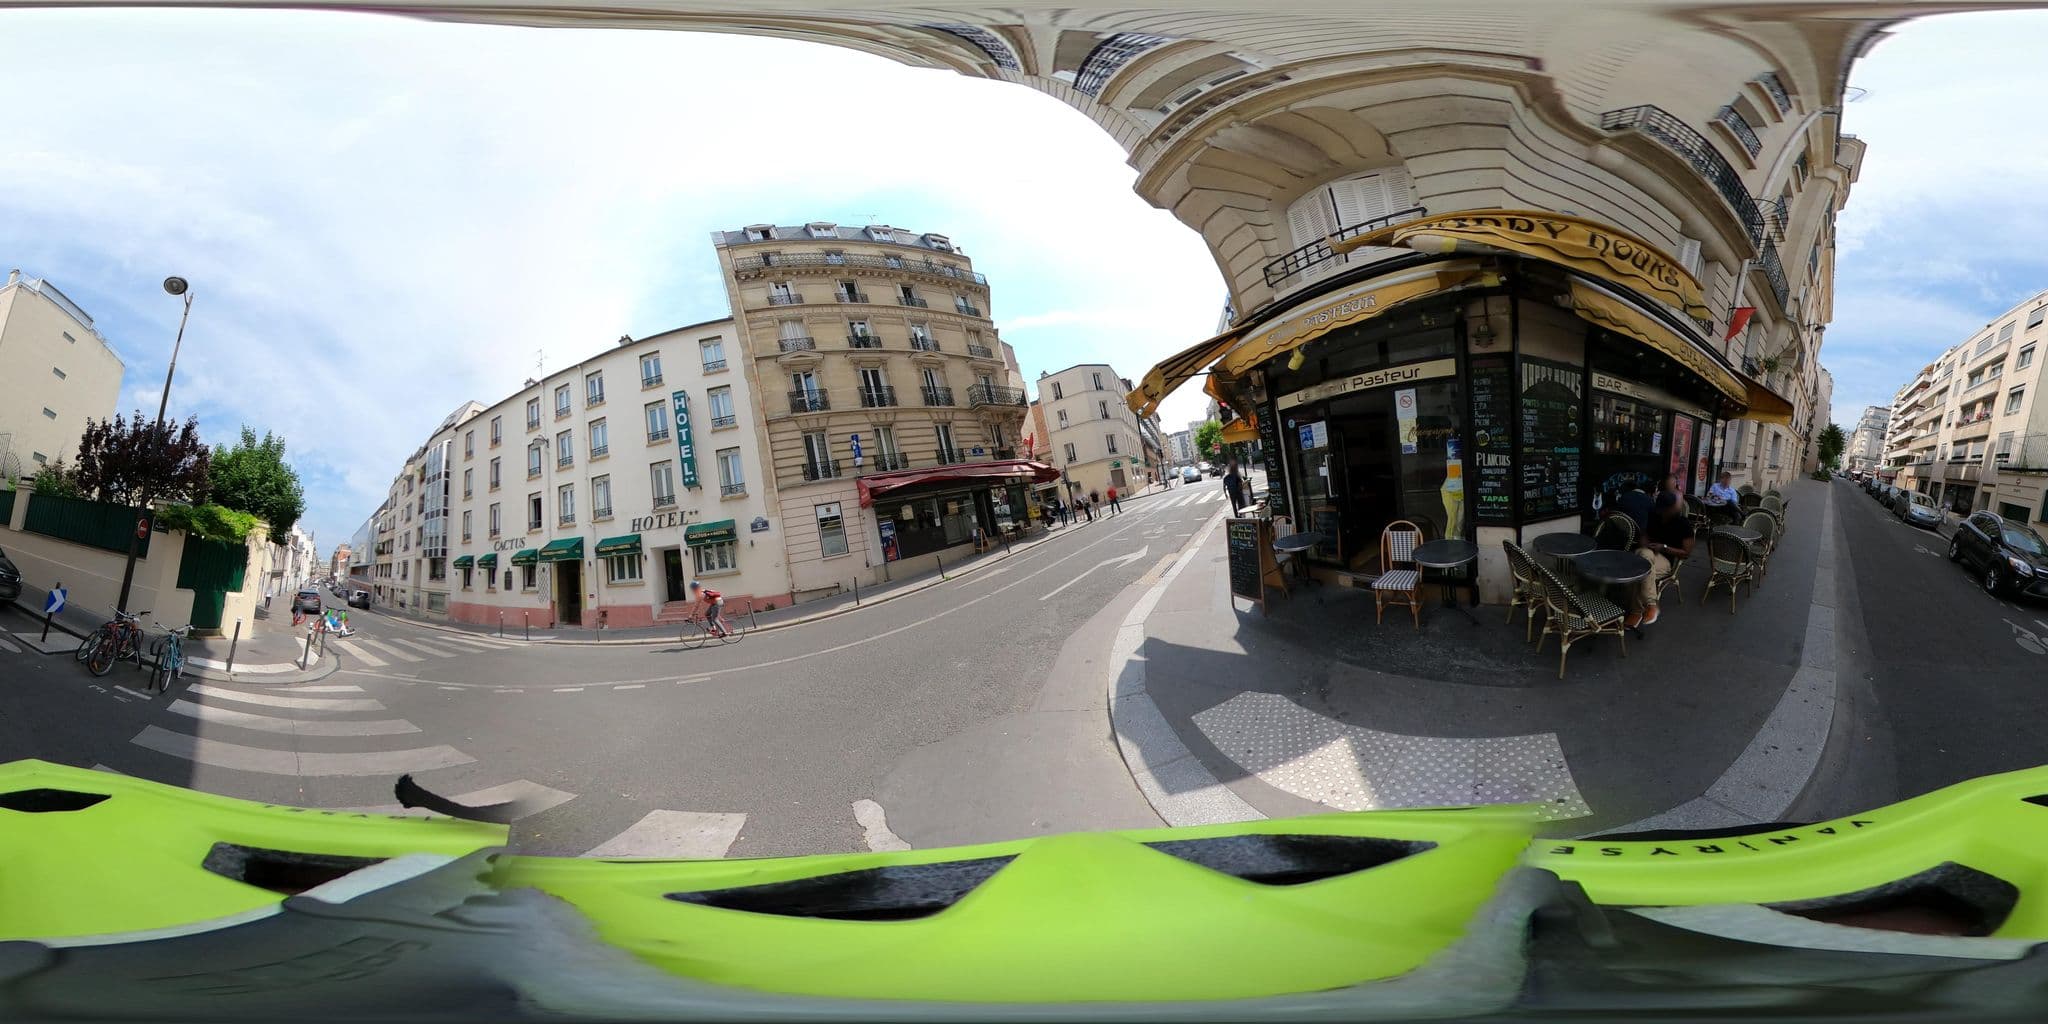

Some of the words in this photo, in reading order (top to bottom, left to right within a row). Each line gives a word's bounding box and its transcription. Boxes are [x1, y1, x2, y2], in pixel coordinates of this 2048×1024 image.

[1353, 368, 1420, 389] Pasteur
[1597, 376, 1622, 391] BAR
[674, 397, 693, 476] HOTEL
[631, 510, 689, 533] HOTEL
[493, 537, 526, 552] CACTUS
